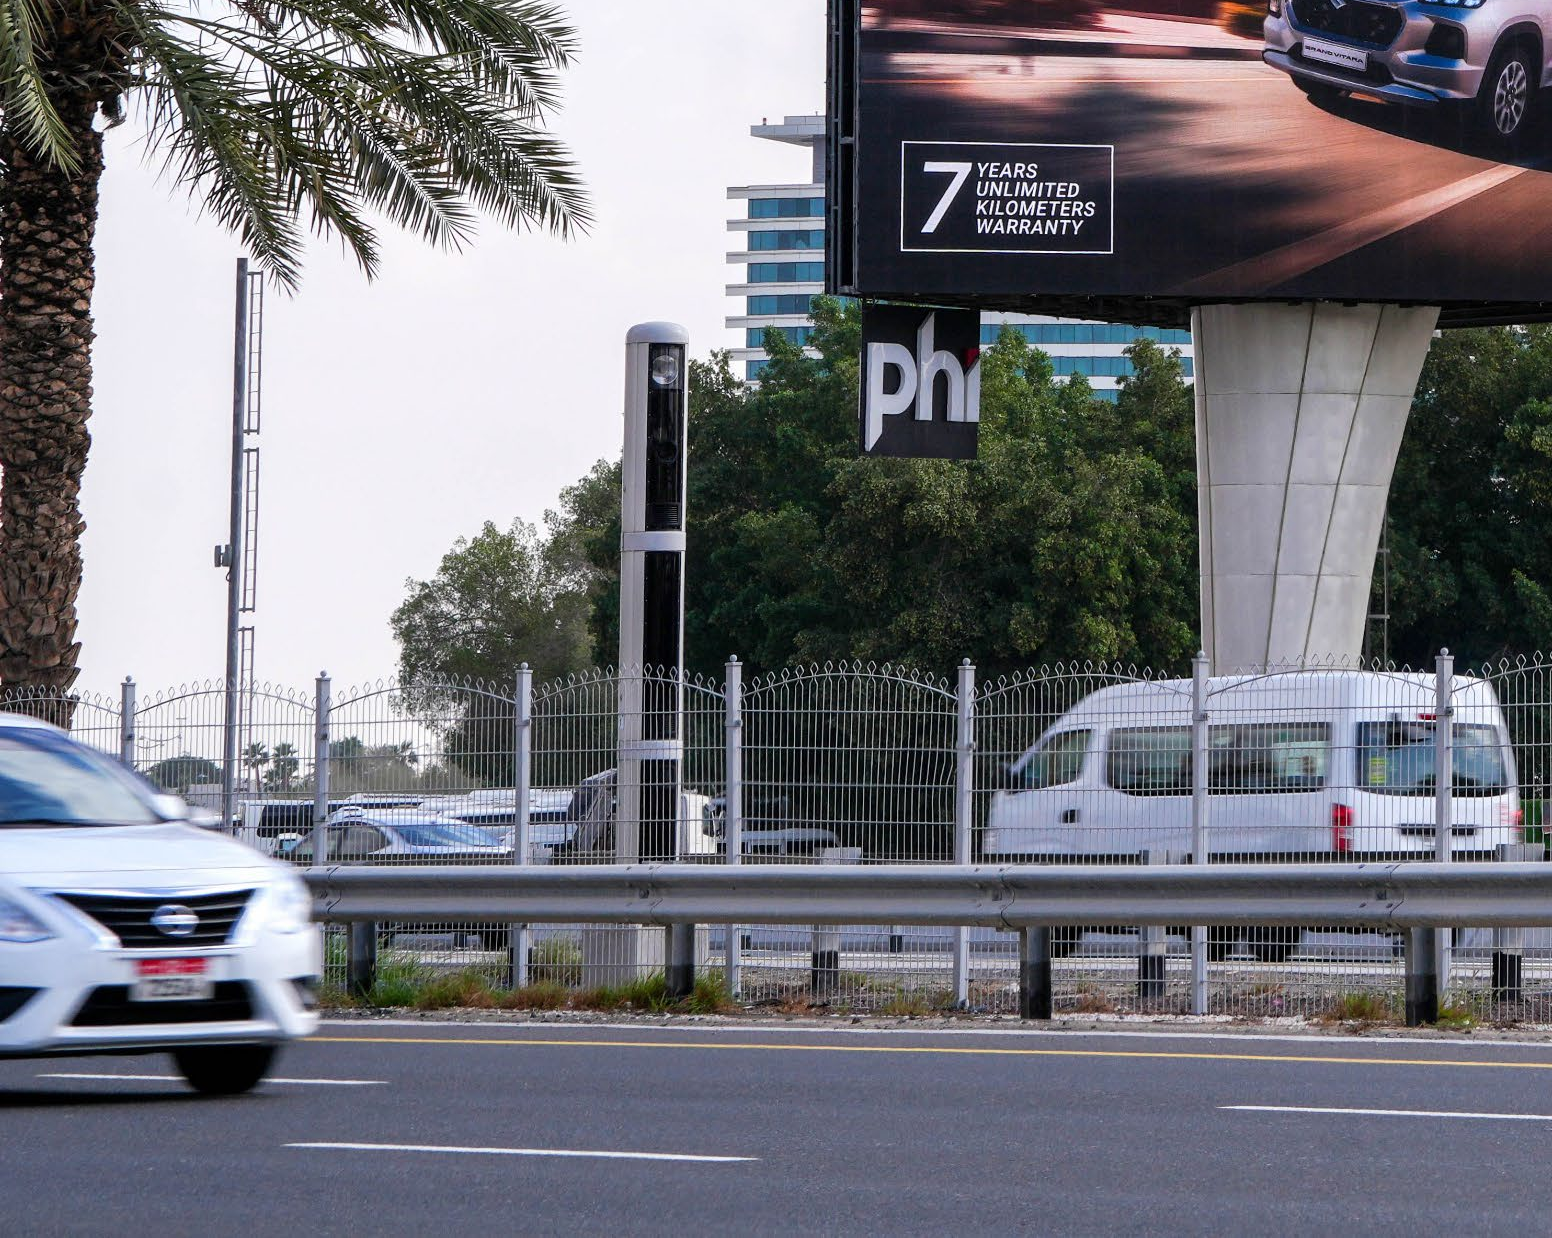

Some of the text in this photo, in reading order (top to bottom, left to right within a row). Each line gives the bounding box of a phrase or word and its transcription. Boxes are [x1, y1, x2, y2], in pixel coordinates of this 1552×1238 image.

[976, 162, 1038, 179] YEARS
[920, 161, 973, 234] 7
[975, 181, 1080, 198] UNLIMITED
[975, 199, 1096, 217] KILOMETERS
[976, 218, 1084, 236] WARRANTY
